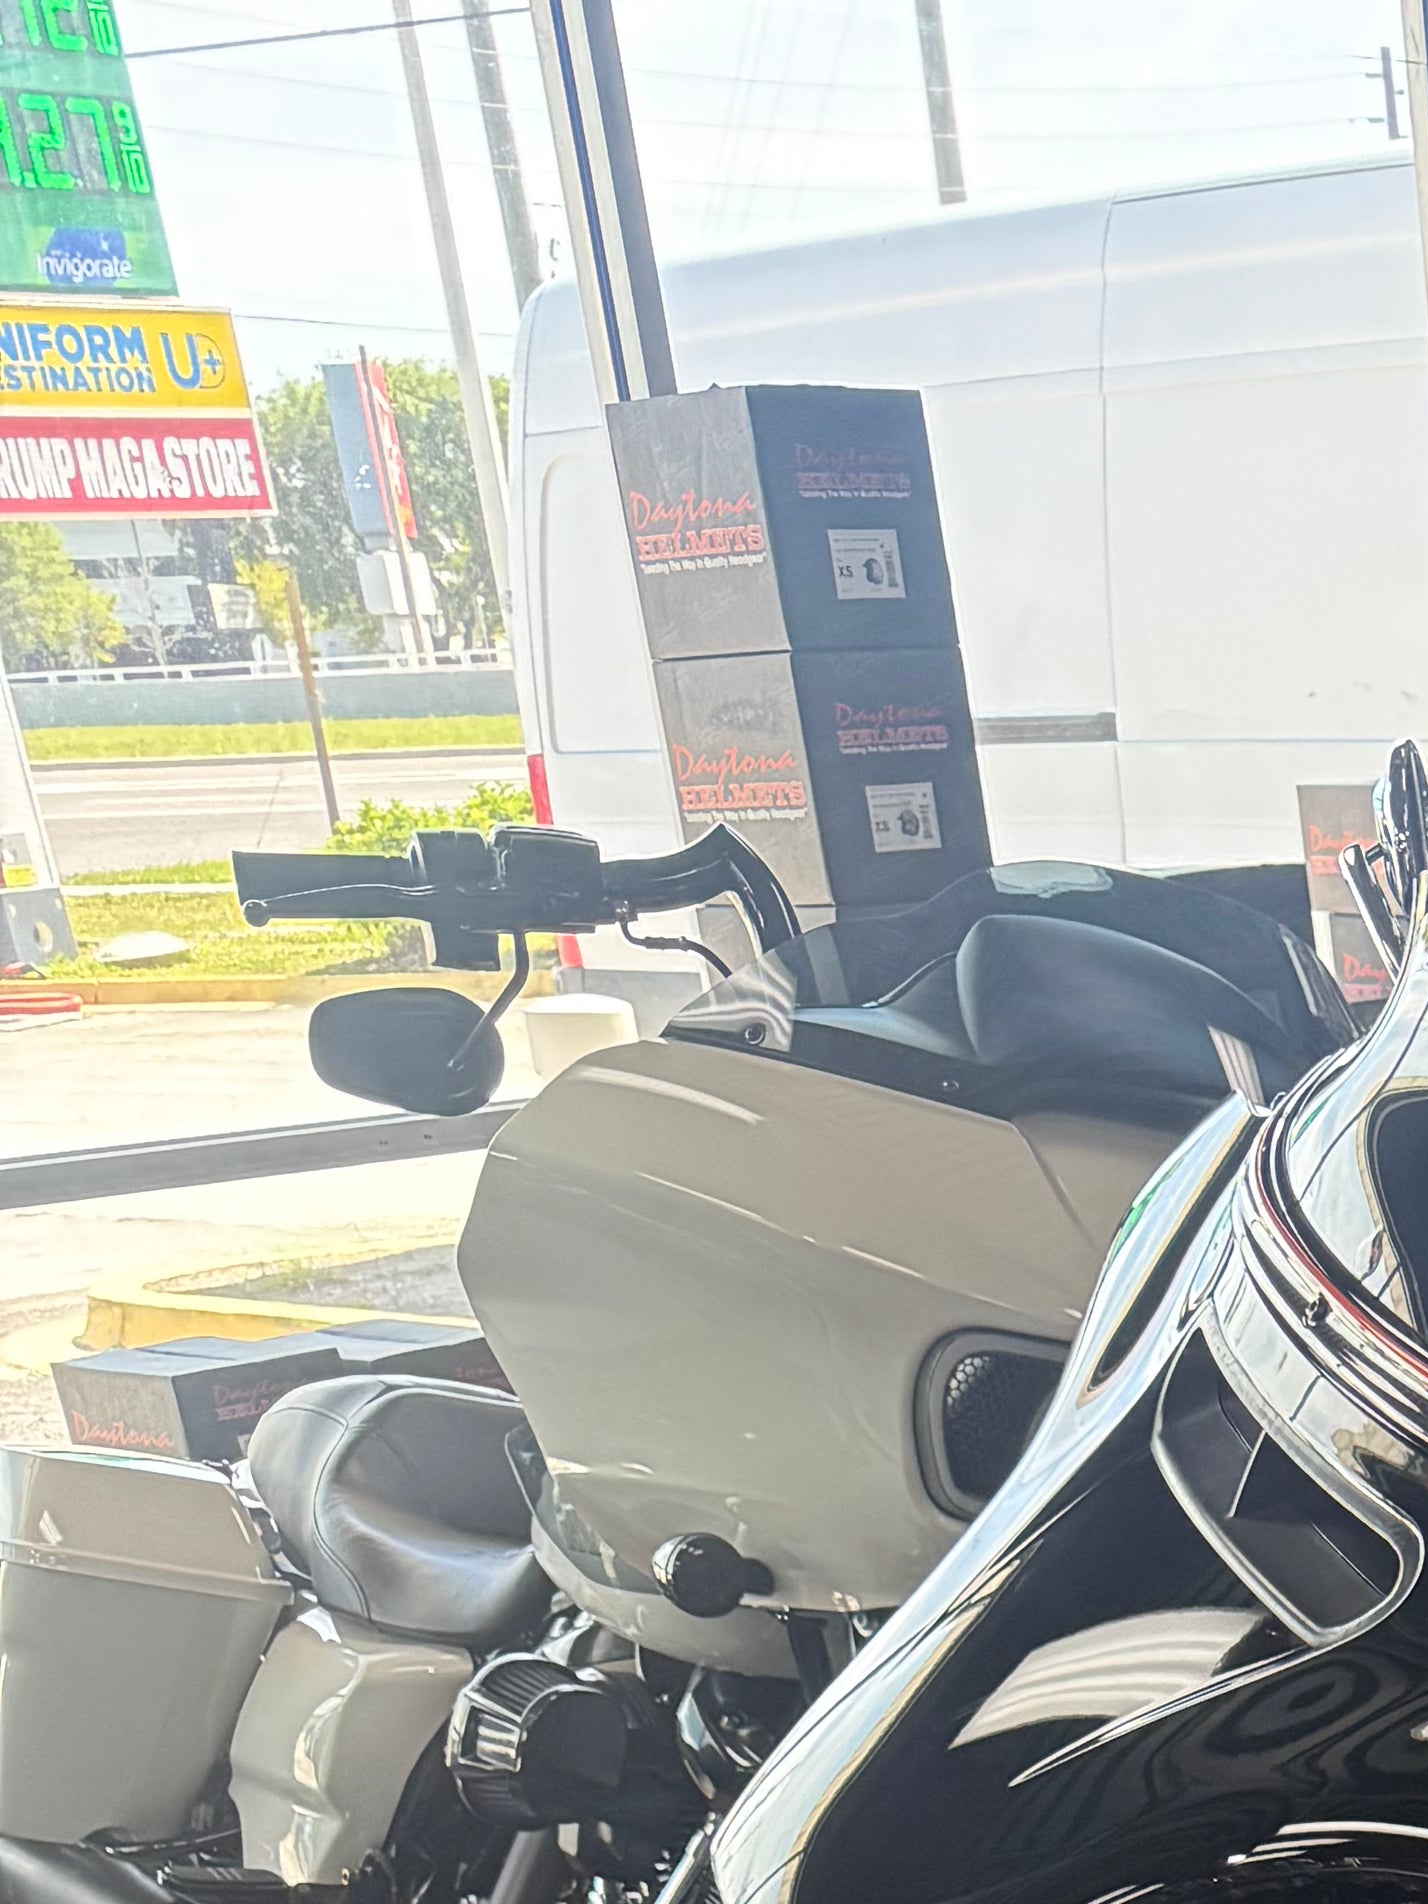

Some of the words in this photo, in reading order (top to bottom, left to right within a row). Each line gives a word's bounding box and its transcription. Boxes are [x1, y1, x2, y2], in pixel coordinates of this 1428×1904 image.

[0, 364, 157, 393] STINATION
[73, 437, 171, 498] MAGA
[163, 436, 261, 498] STORE
[629, 488, 756, 533] Daytona
[635, 524, 765, 562] HELMETS
[838, 565, 853, 578] XS
[672, 744, 797, 783] Daytona
[679, 781, 807, 810] HELMETS
[71, 1410, 175, 1450] Daytona
